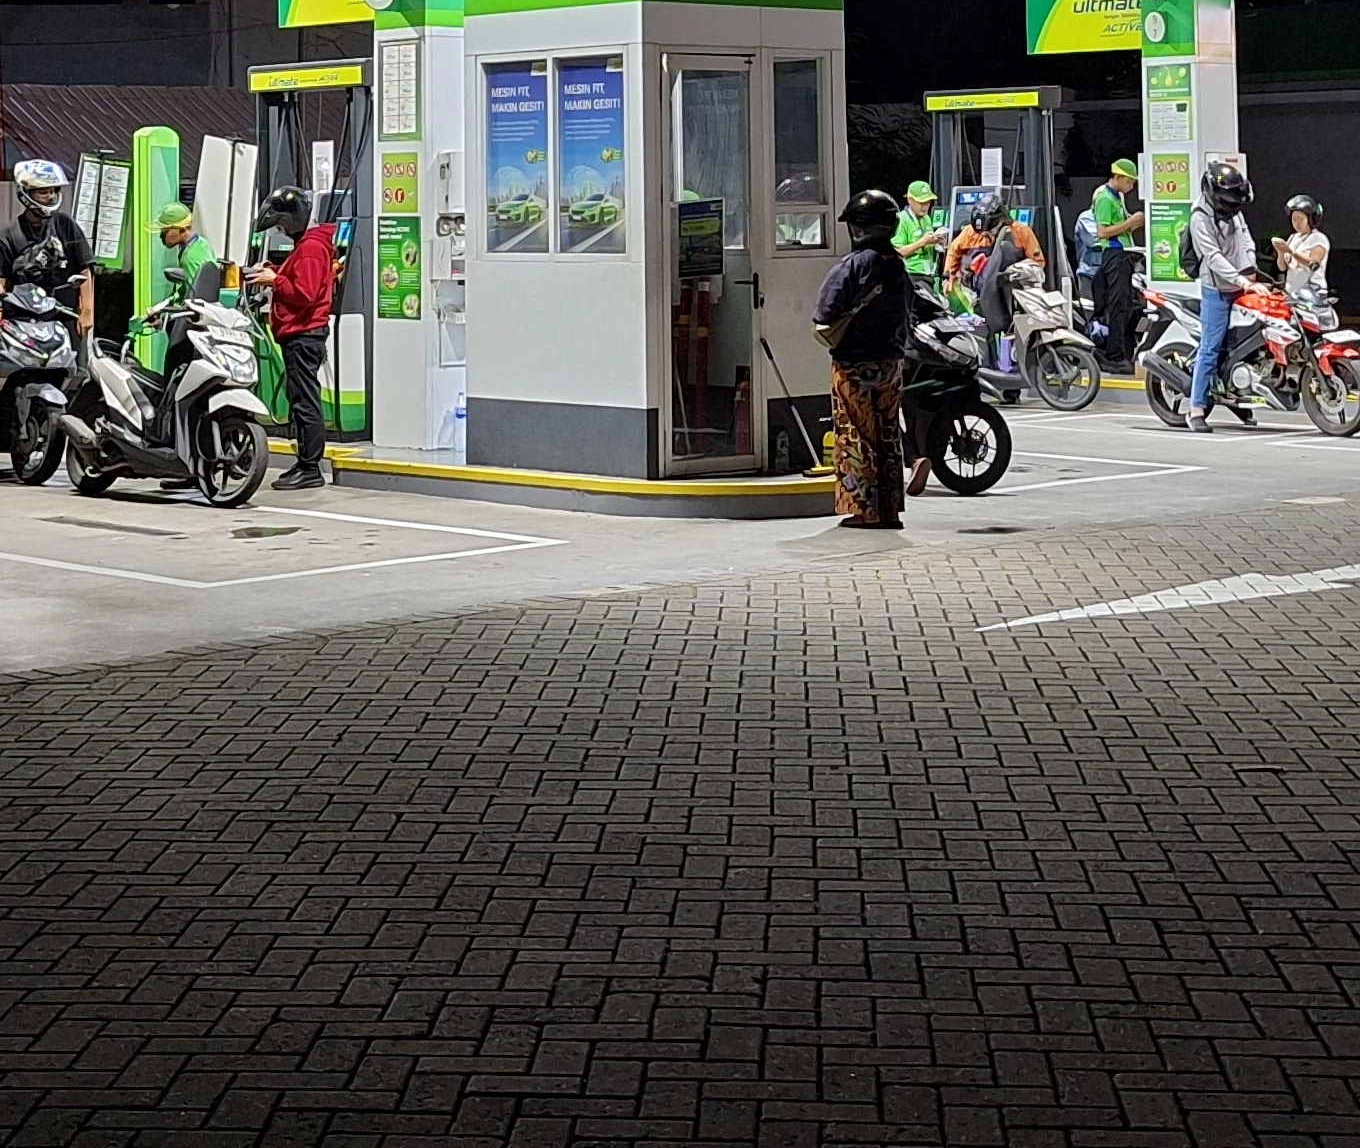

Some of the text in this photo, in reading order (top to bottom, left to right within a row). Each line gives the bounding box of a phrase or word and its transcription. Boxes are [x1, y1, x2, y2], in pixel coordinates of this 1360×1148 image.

[1151, 15, 1158, 26] 9
[1151, 29, 1158, 40] 7
[491, 87, 517, 99] MESIN
[564, 83, 591, 95] MESIN
[491, 102, 518, 113] MAKIN
[564, 99, 592, 111] MAKIN
